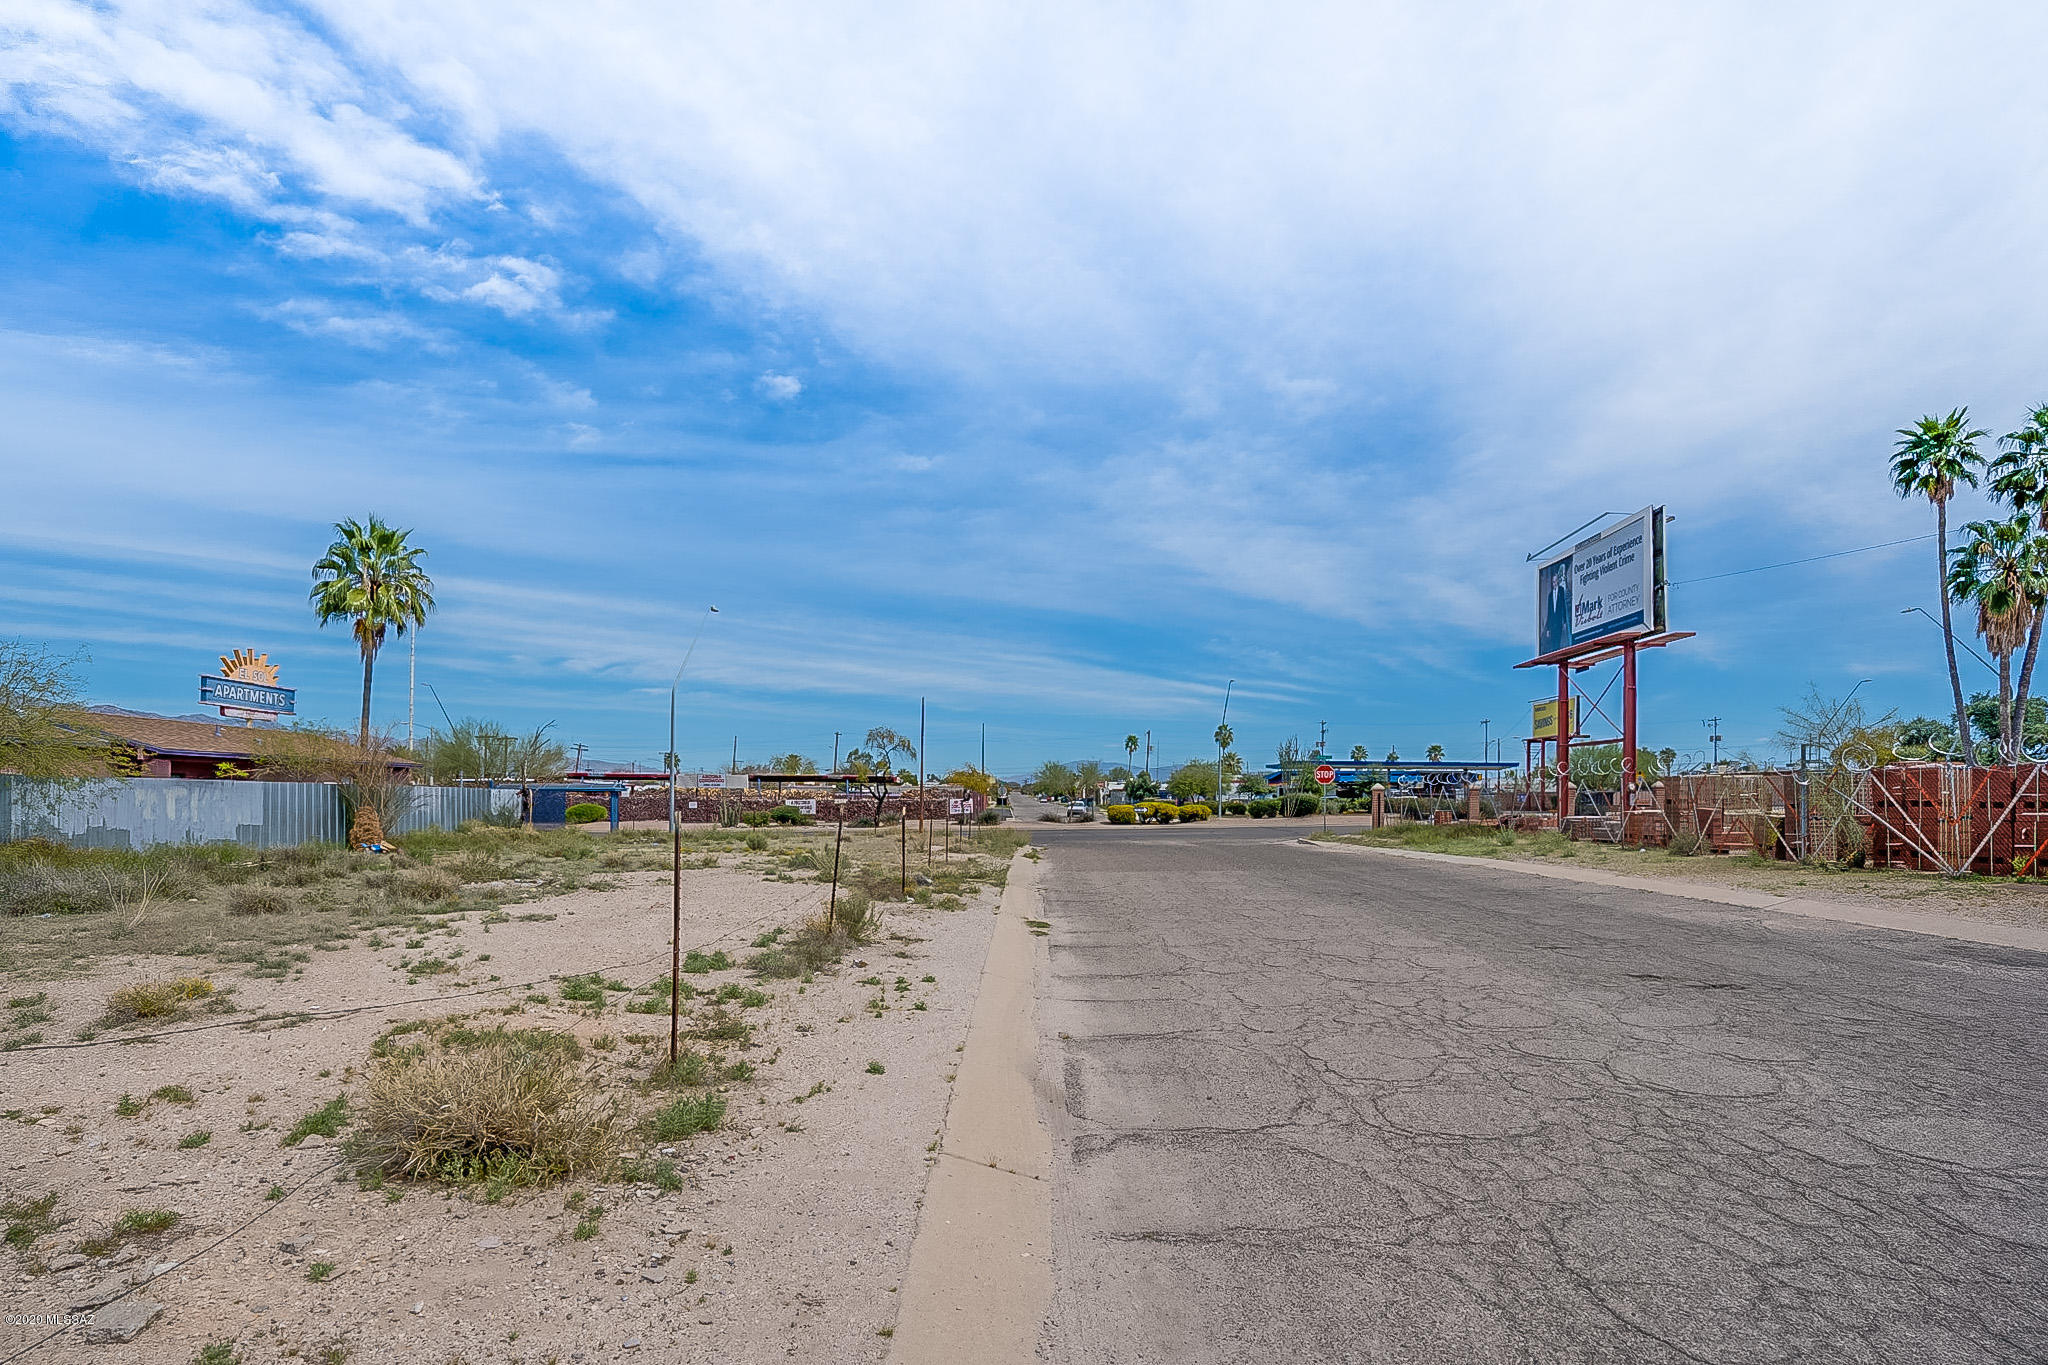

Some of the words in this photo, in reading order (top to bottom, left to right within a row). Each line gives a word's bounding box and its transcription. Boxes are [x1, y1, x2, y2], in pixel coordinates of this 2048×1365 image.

[1574, 562, 1586, 574] Over
[1586, 557, 1592, 570] 20
[1592, 552, 1607, 566] Years
[1607, 546, 1613, 559] of
[1613, 534, 1643, 556] Experience
[1580, 568, 1600, 586] Fighting
[1600, 559, 1618, 576] Violent
[1618, 552, 1635, 567] Crime
[1607, 591, 1618, 602] FOR
[1618, 583, 1640, 599] COUNTY
[1581, 595, 1603, 615] Mark
[1607, 594, 1641, 615] ATTORNEY
[239, 668, 250, 680] EL
[252, 670, 268, 682] SOL
[214, 684, 286, 707] APARTMENTS
[1316, 770, 1334, 779] STOP
